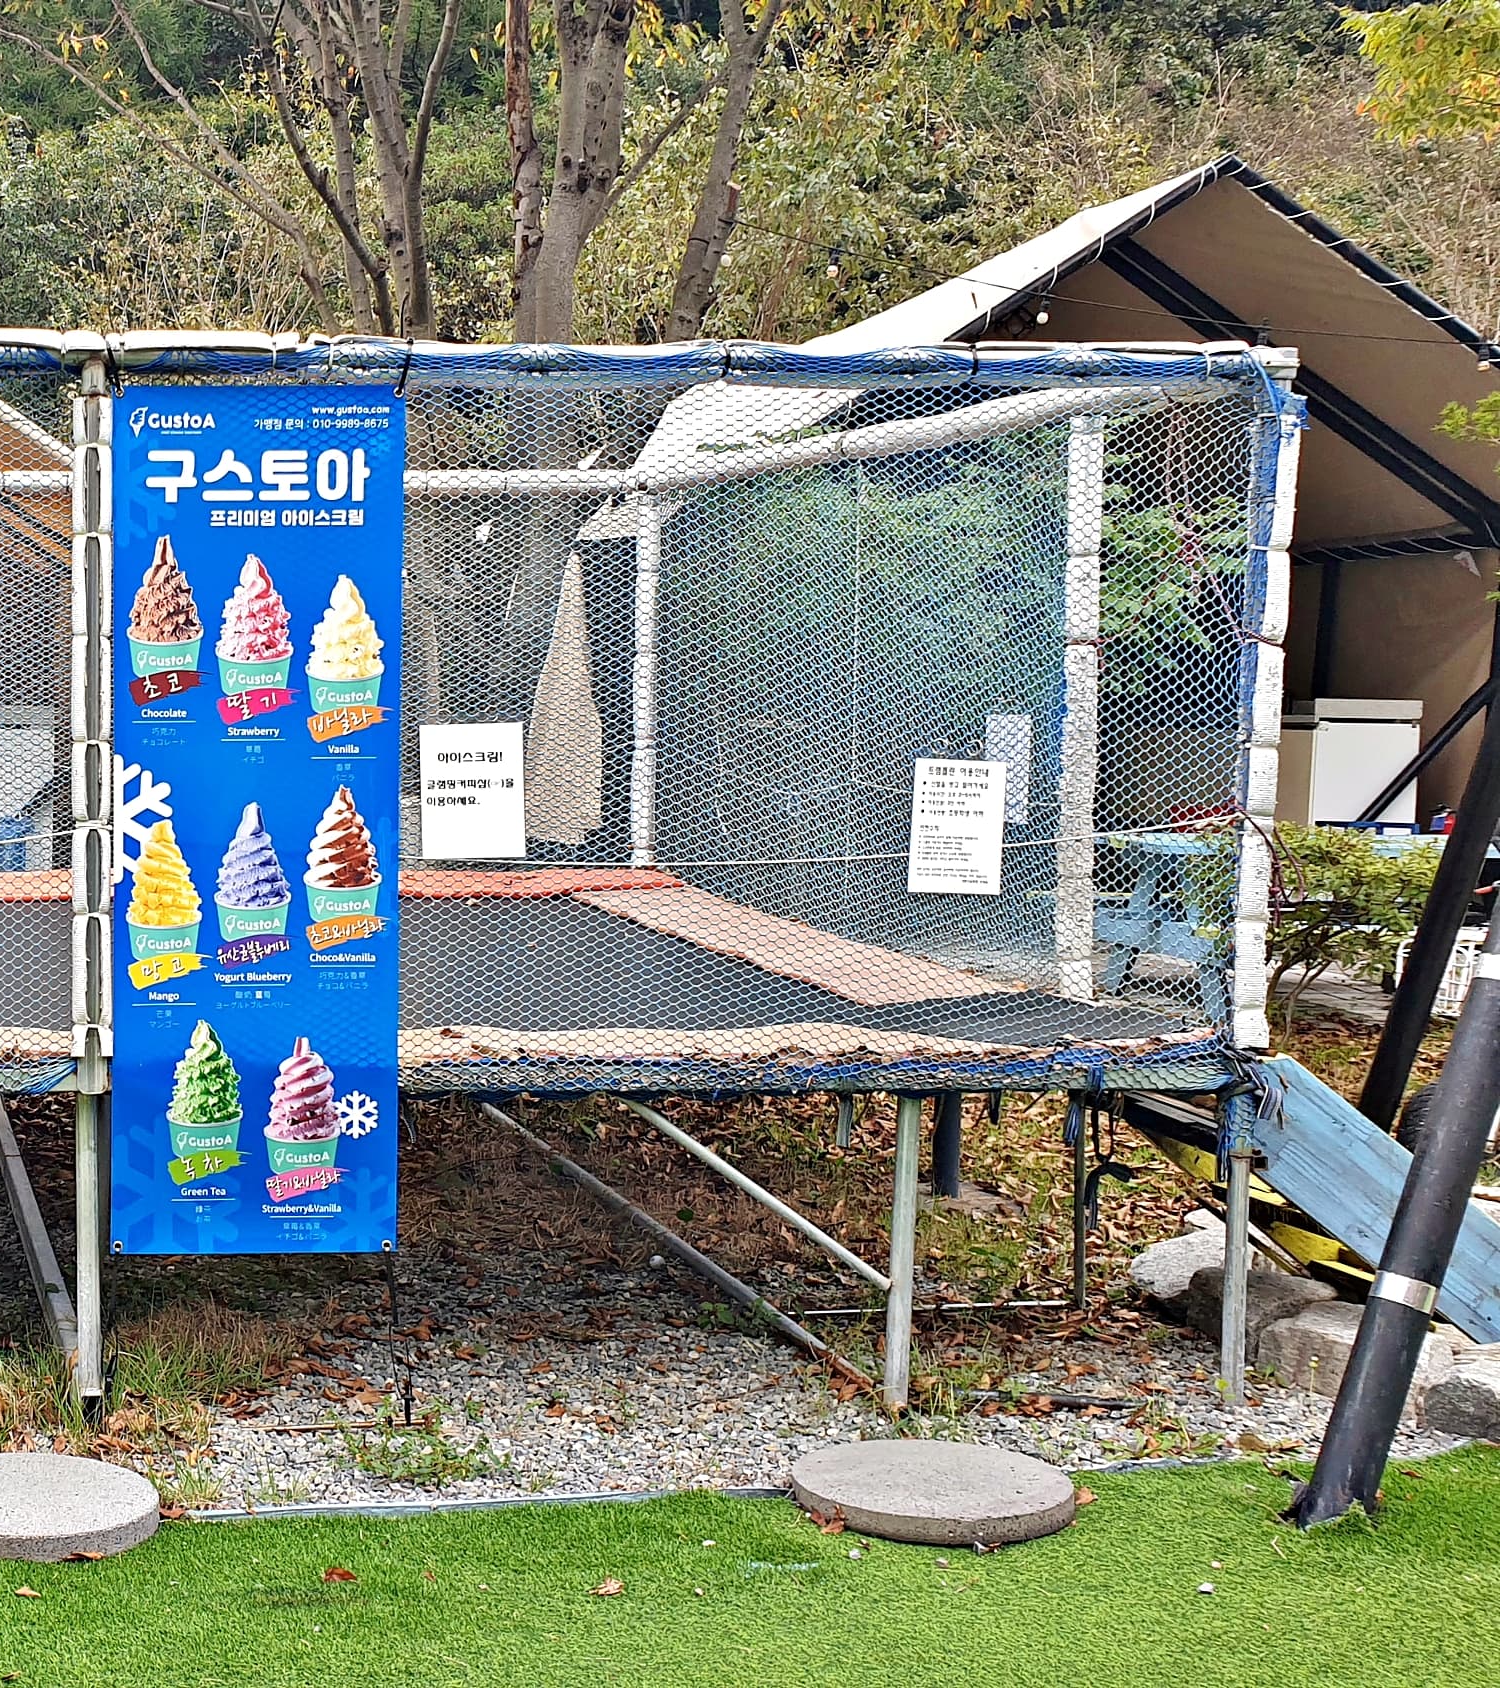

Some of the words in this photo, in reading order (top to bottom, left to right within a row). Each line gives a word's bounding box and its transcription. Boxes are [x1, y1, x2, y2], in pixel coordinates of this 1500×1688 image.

[311, 406, 390, 416] www.gustoa.com
[147, 412, 216, 429] GustoA
[253, 418, 282, 430] 가맹점
[285, 418, 304, 430] 문의
[145, 448, 371, 503] 구스토아
[210, 509, 276, 527] 프리미엄
[281, 509, 364, 527] 아이스크림
[149, 653, 193, 666] GustoA
[238, 671, 283, 685] GustoA
[327, 689, 373, 703] GustoA
[141, 708, 187, 718] Chocolate
[313, 707, 373, 735] 바닐라
[227, 726, 280, 738] Strawberry
[327, 744, 360, 754] Vanilla
[326, 899, 371, 912] GustoA
[236, 917, 281, 931] GustoA
[147, 936, 192, 950] GustoA
[309, 953, 376, 962] Choco&Vanilla
[213, 972, 245, 984] Yogurt
[246, 971, 292, 983] Blueberry
[148, 991, 180, 1003] Mango
[188, 1134, 233, 1147] GustoA
[285, 1151, 330, 1164] GustoA
[180, 1187, 208, 1196] Green
[210, 1186, 227, 1196] Tea
[262, 1203, 342, 1215] Strawberry&Vanilla
